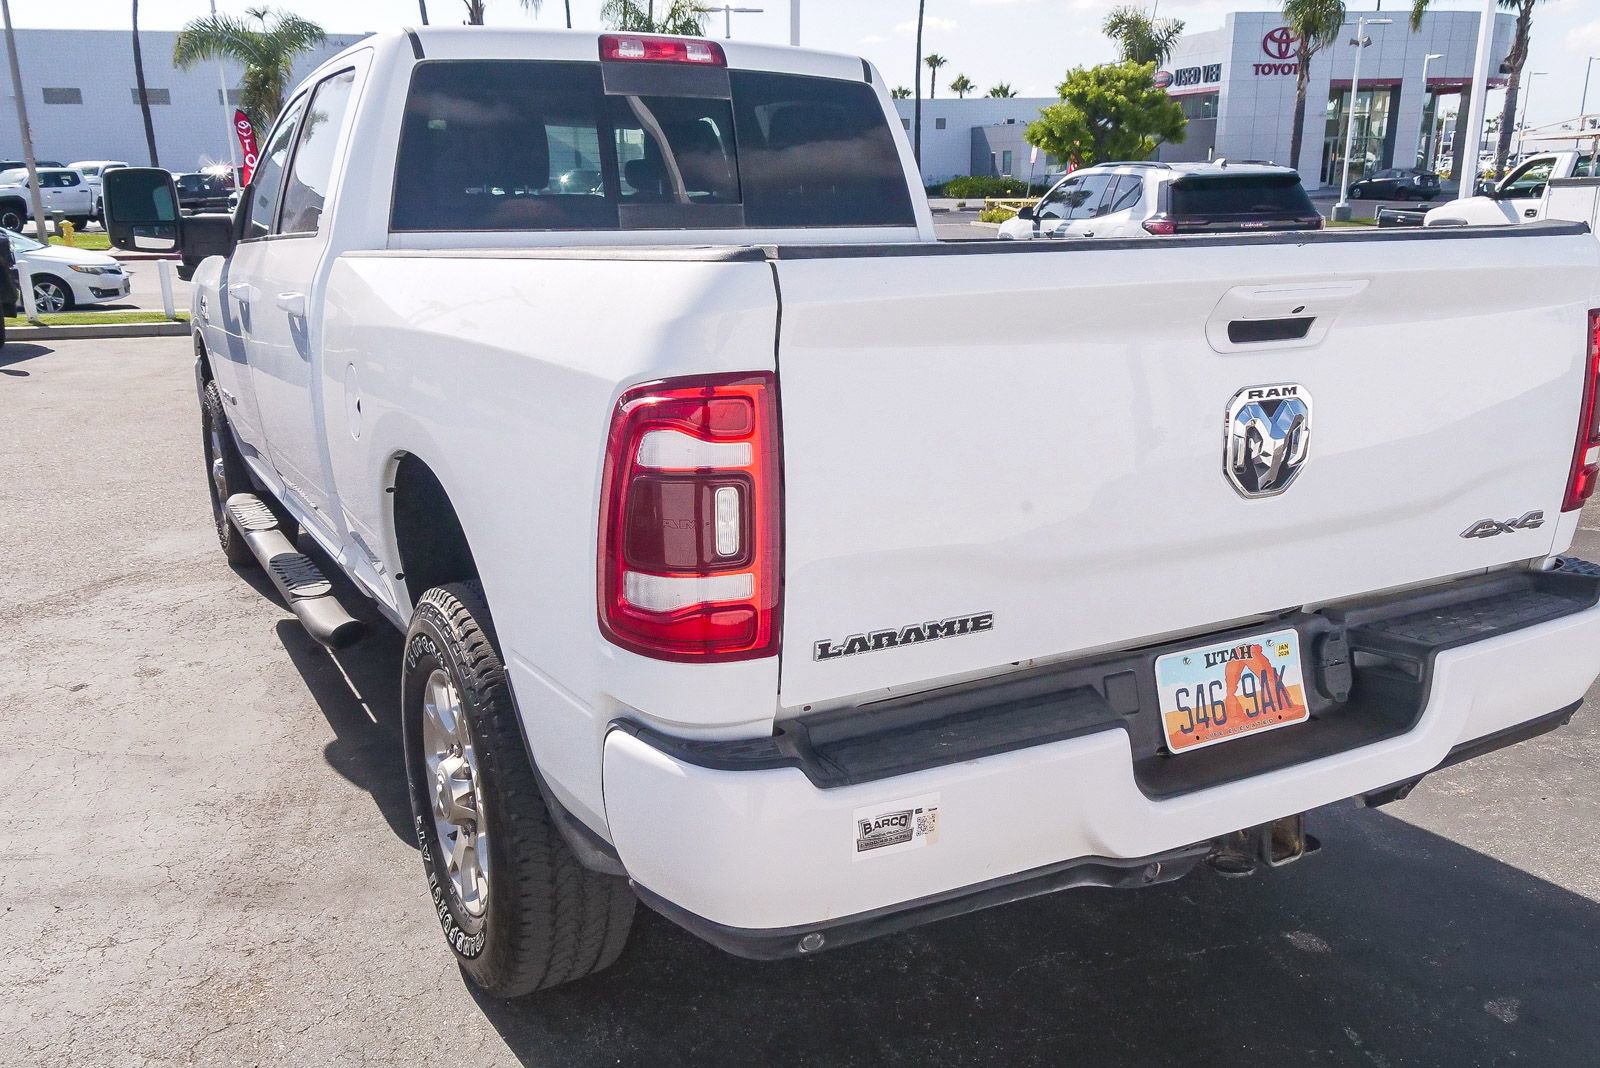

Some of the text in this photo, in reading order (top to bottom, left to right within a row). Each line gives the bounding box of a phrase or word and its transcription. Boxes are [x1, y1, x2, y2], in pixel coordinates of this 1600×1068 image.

[1174, 67, 1201, 86] USED
[1253, 62, 1299, 76] TOYOT
[1247, 386, 1298, 400] RAM
[813, 610, 994, 662] LARAMIE
[1204, 644, 1253, 669] UTAH
[1277, 643, 1289, 651] JAN
[1175, 664, 1294, 735] S46 9AK
[1228, 718, 1274, 734] ELEVATED
[862, 815, 908, 836] BARCO
